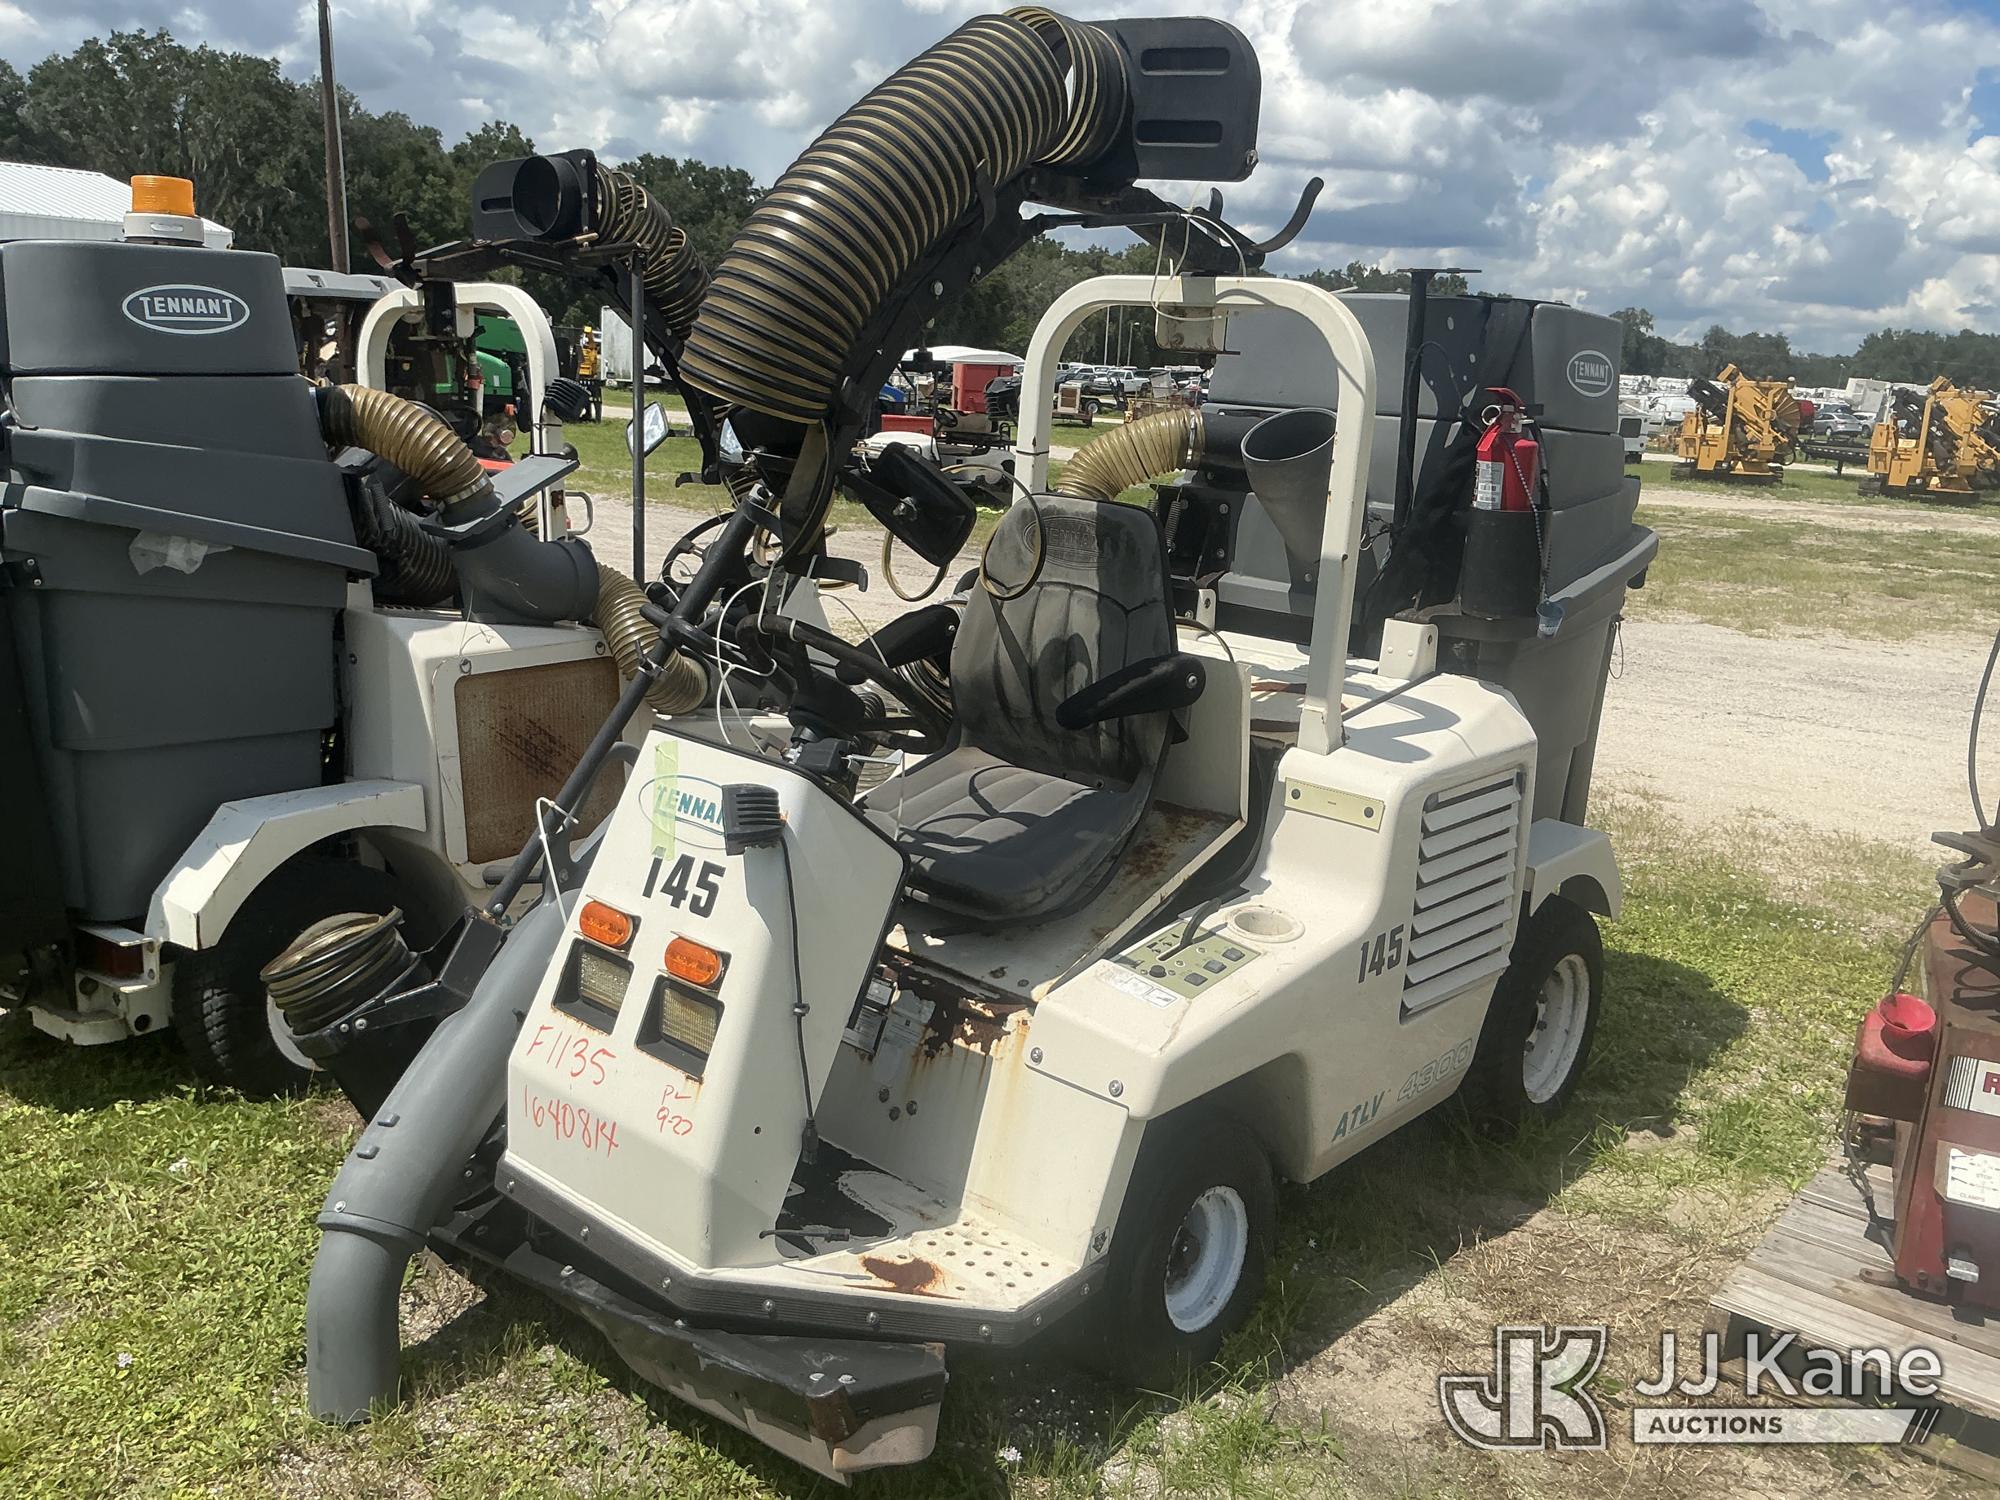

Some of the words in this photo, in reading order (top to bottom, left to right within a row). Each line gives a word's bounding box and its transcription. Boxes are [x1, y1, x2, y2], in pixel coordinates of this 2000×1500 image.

[139, 296, 232, 321] TENNANT
[1574, 360, 1609, 385] TENNANT
[642, 846, 726, 919] 145
[1358, 923, 1404, 984] 145
[526, 1024, 617, 1086] F1135
[523, 1083, 619, 1158] 1640814
[1331, 1090, 1385, 1143] ATLV
[1397, 1037, 1473, 1102] 4300
